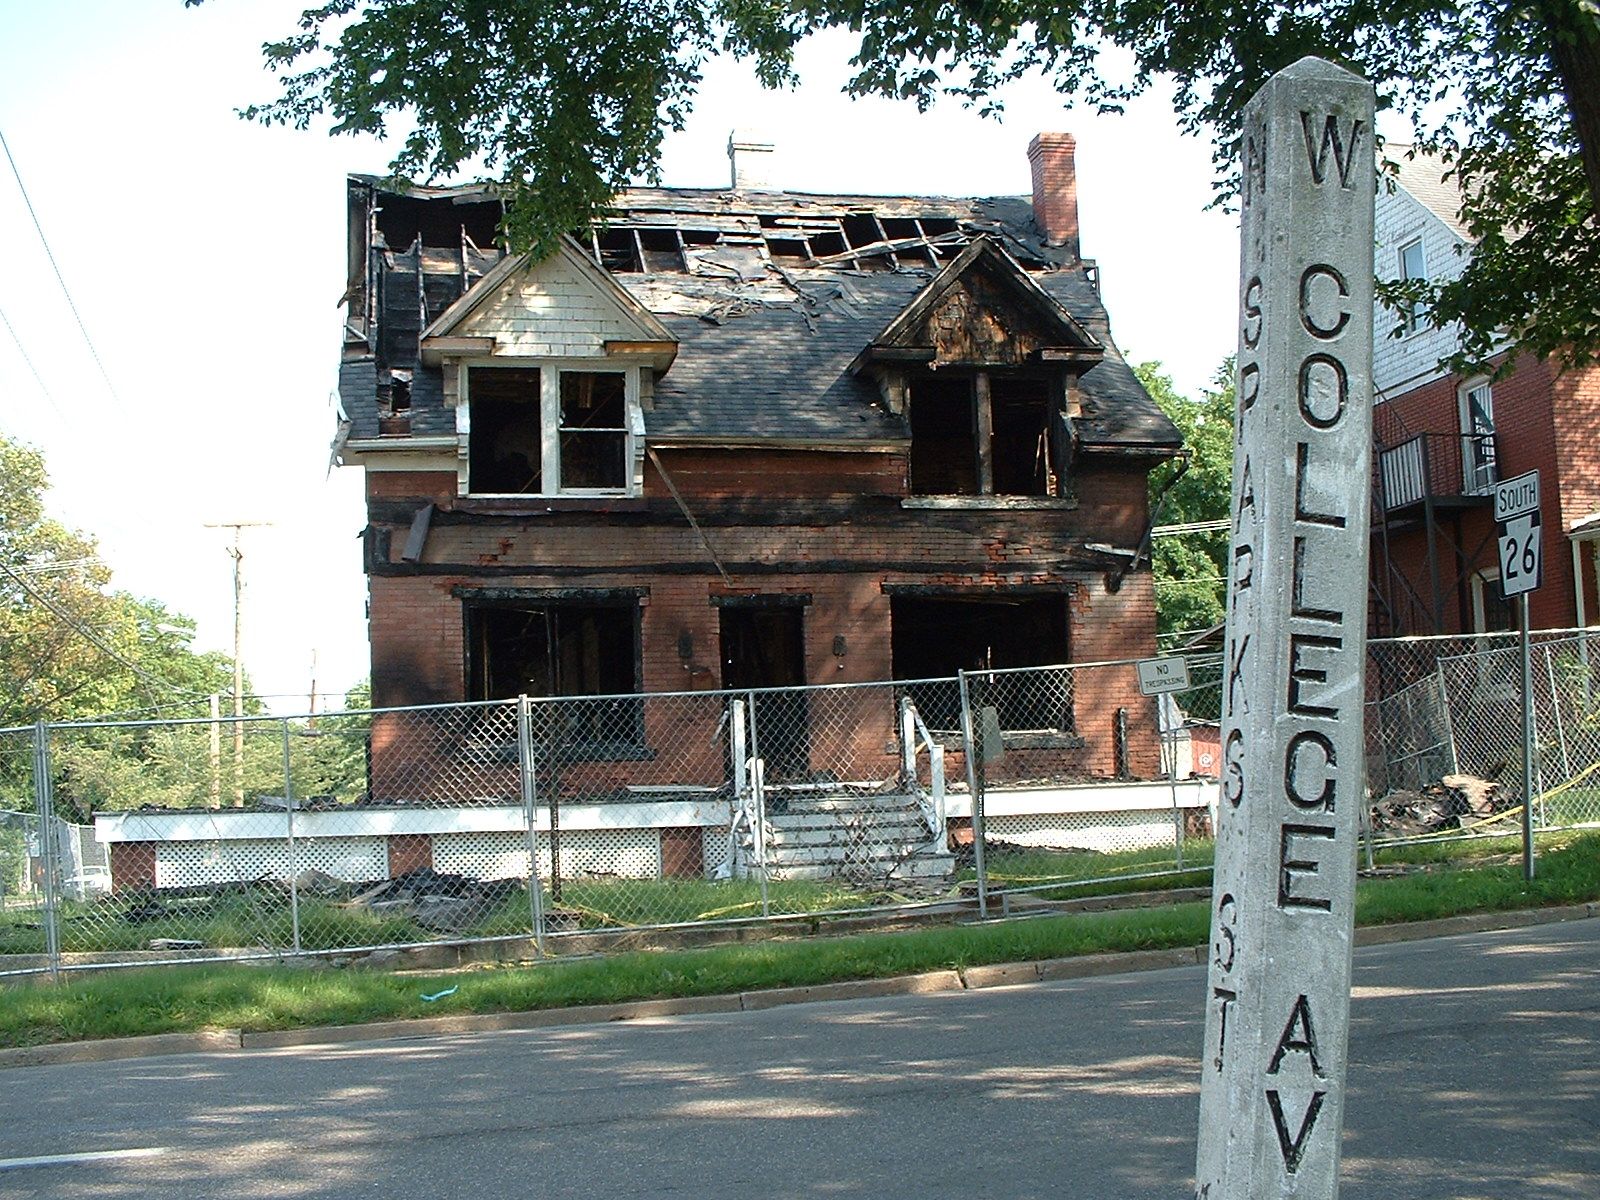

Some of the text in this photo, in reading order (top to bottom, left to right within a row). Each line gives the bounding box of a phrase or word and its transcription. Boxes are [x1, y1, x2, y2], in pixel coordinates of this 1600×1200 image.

[1223, 275, 1263, 811] SPARKS
[1499, 481, 1536, 512] SOUTH
[1505, 532, 1535, 580] 26
[1155, 664, 1169, 675] NO
[1265, 111, 1365, 1175] W COLLEGE AV
[1213, 892, 1237, 1073] ST
